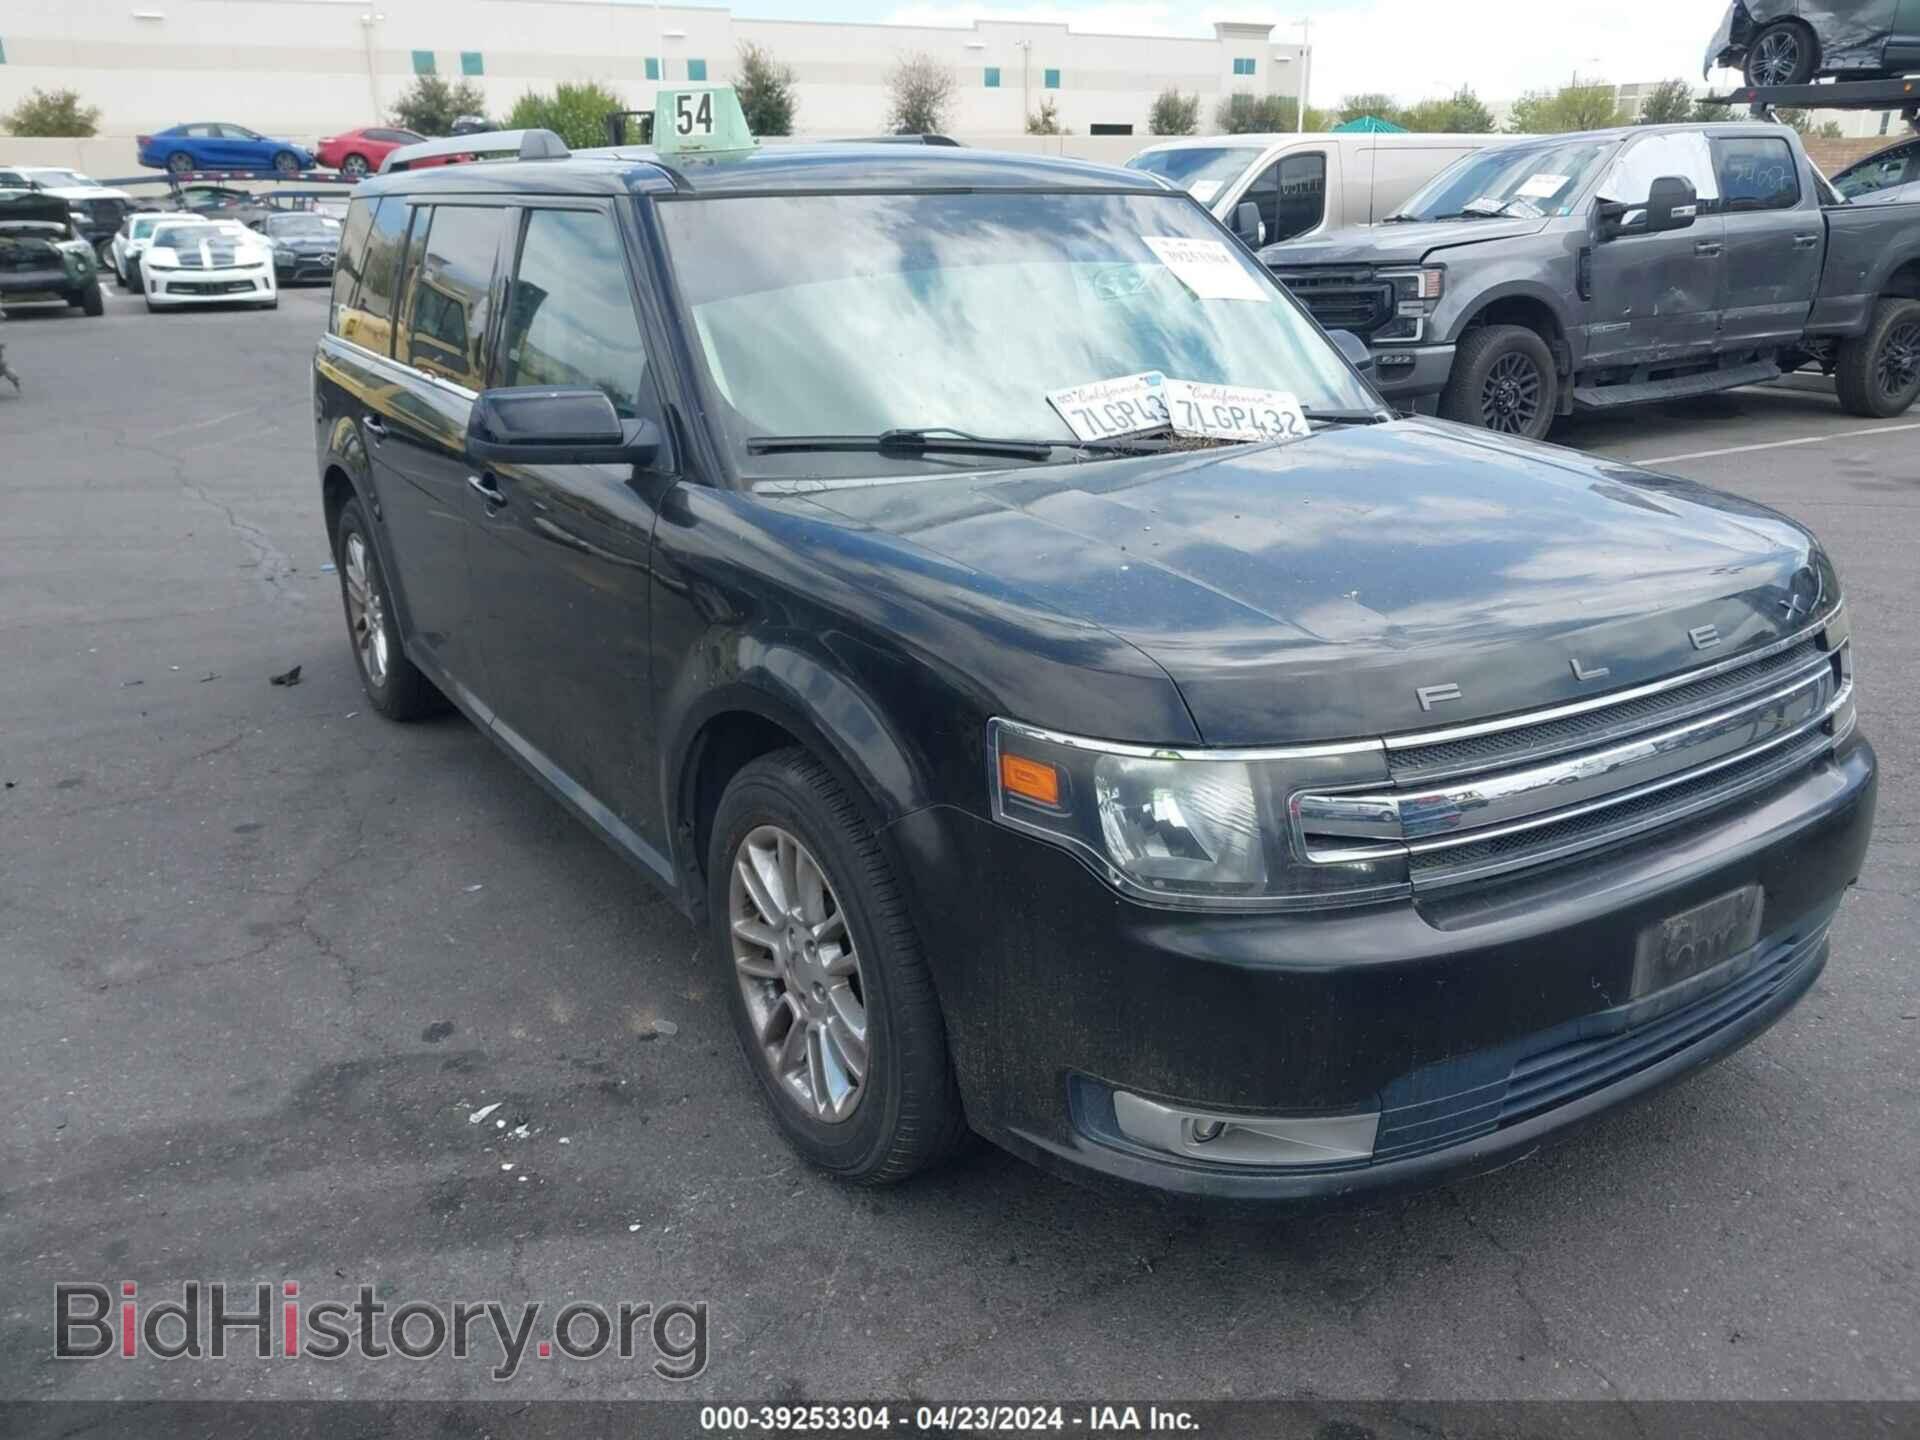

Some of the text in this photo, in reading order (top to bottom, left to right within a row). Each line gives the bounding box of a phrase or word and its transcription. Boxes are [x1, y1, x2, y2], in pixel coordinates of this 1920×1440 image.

[676, 93, 713, 134] 54
[1071, 395, 1170, 435] 7LGP43
[1192, 386, 1265, 405] California
[1176, 399, 1305, 437] 7LGP432
